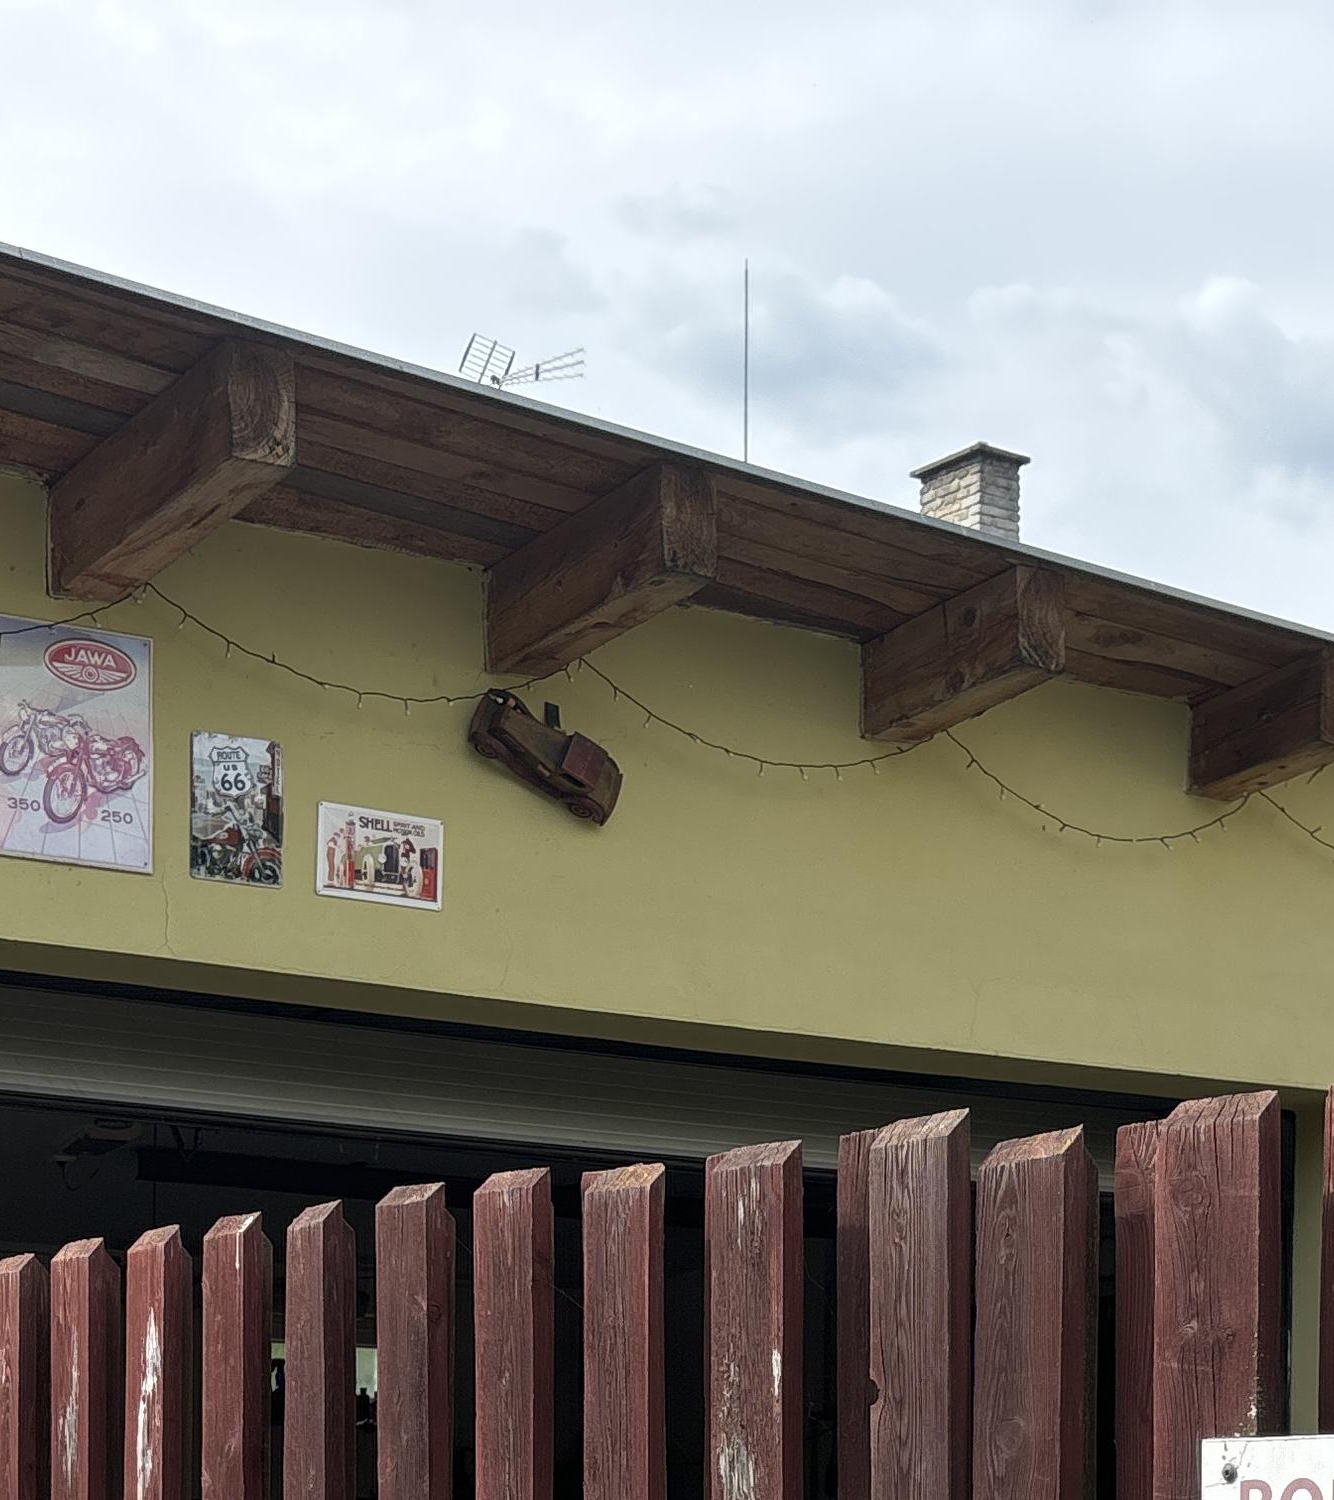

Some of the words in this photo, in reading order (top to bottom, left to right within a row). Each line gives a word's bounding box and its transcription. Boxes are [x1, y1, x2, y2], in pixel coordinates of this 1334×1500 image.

[64, 647, 117, 668] JAWA
[216, 750, 242, 761] ROUTE
[220, 772, 247, 792] 66
[7, 796, 41, 811] 350
[100, 808, 134, 825] 250
[358, 815, 393, 833] SHELL
